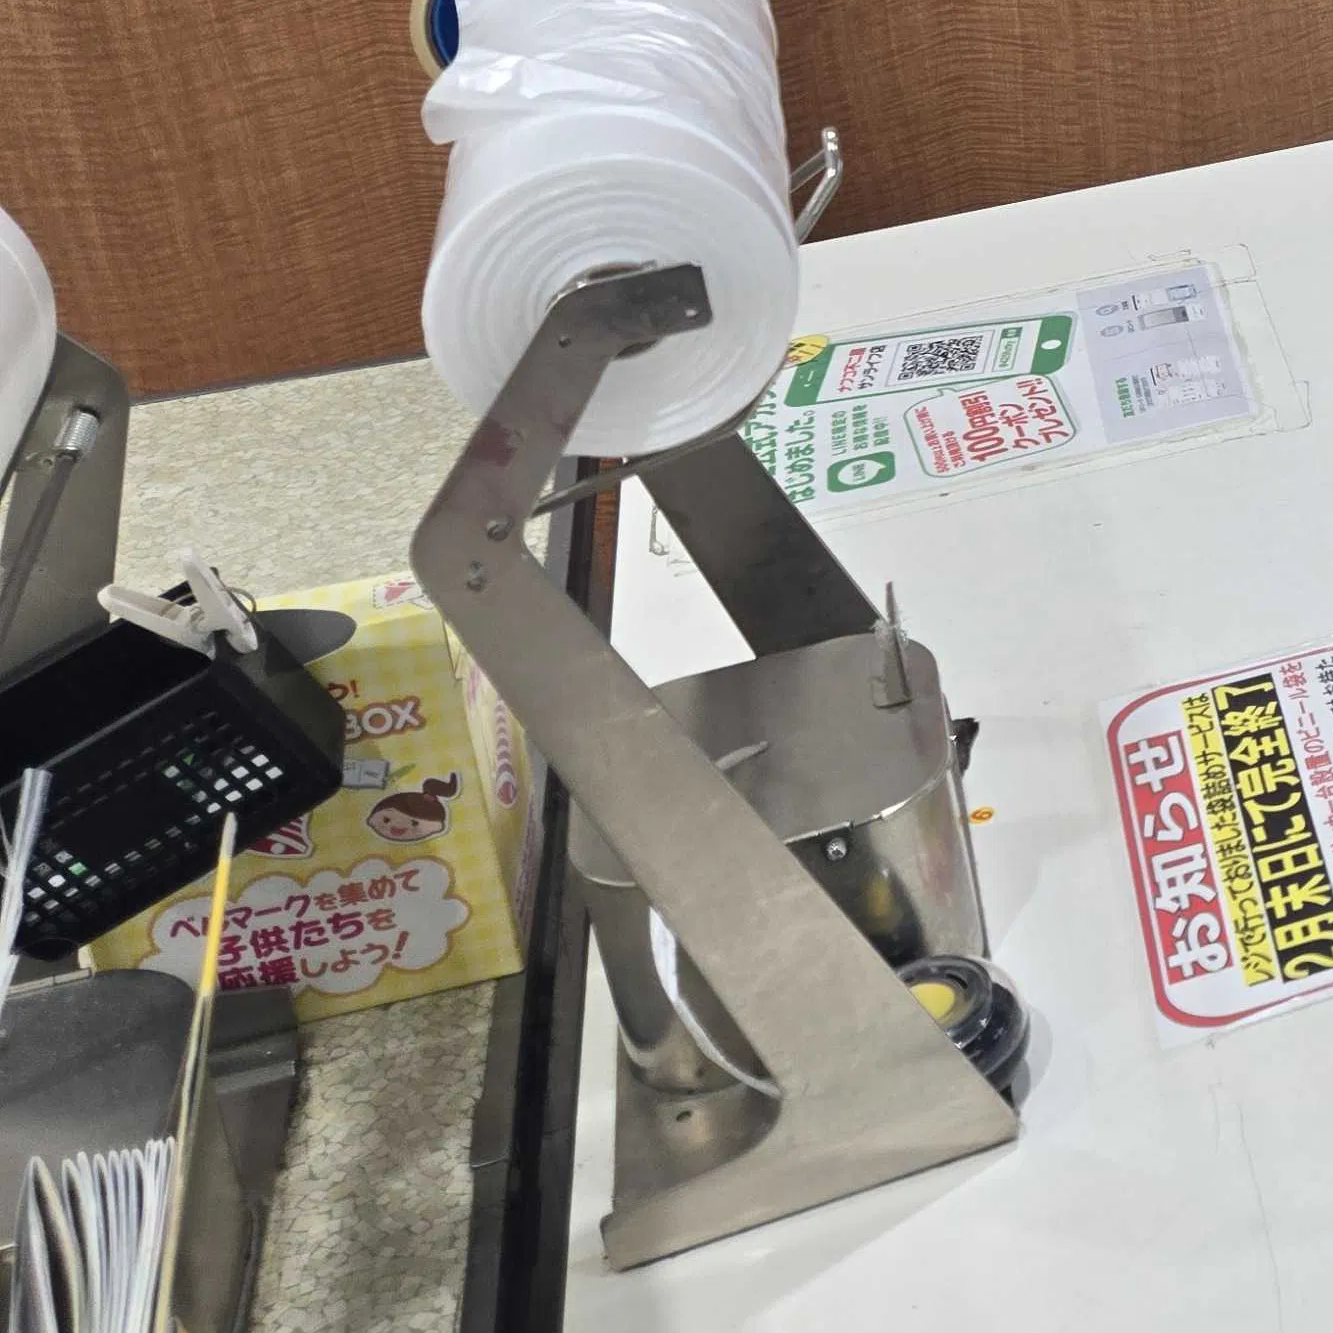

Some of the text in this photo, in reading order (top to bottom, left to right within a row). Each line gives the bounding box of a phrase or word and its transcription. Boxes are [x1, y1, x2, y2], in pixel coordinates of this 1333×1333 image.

[999, 403, 1040, 449] クーポン
[1127, 733, 1232, 983] お知らせ
[1182, 692, 1275, 986] レジで行っておりました袋詰めサービスは
[169, 868, 421, 937] ベルマークを集めて
[215, 905, 398, 965] 子供たちを
